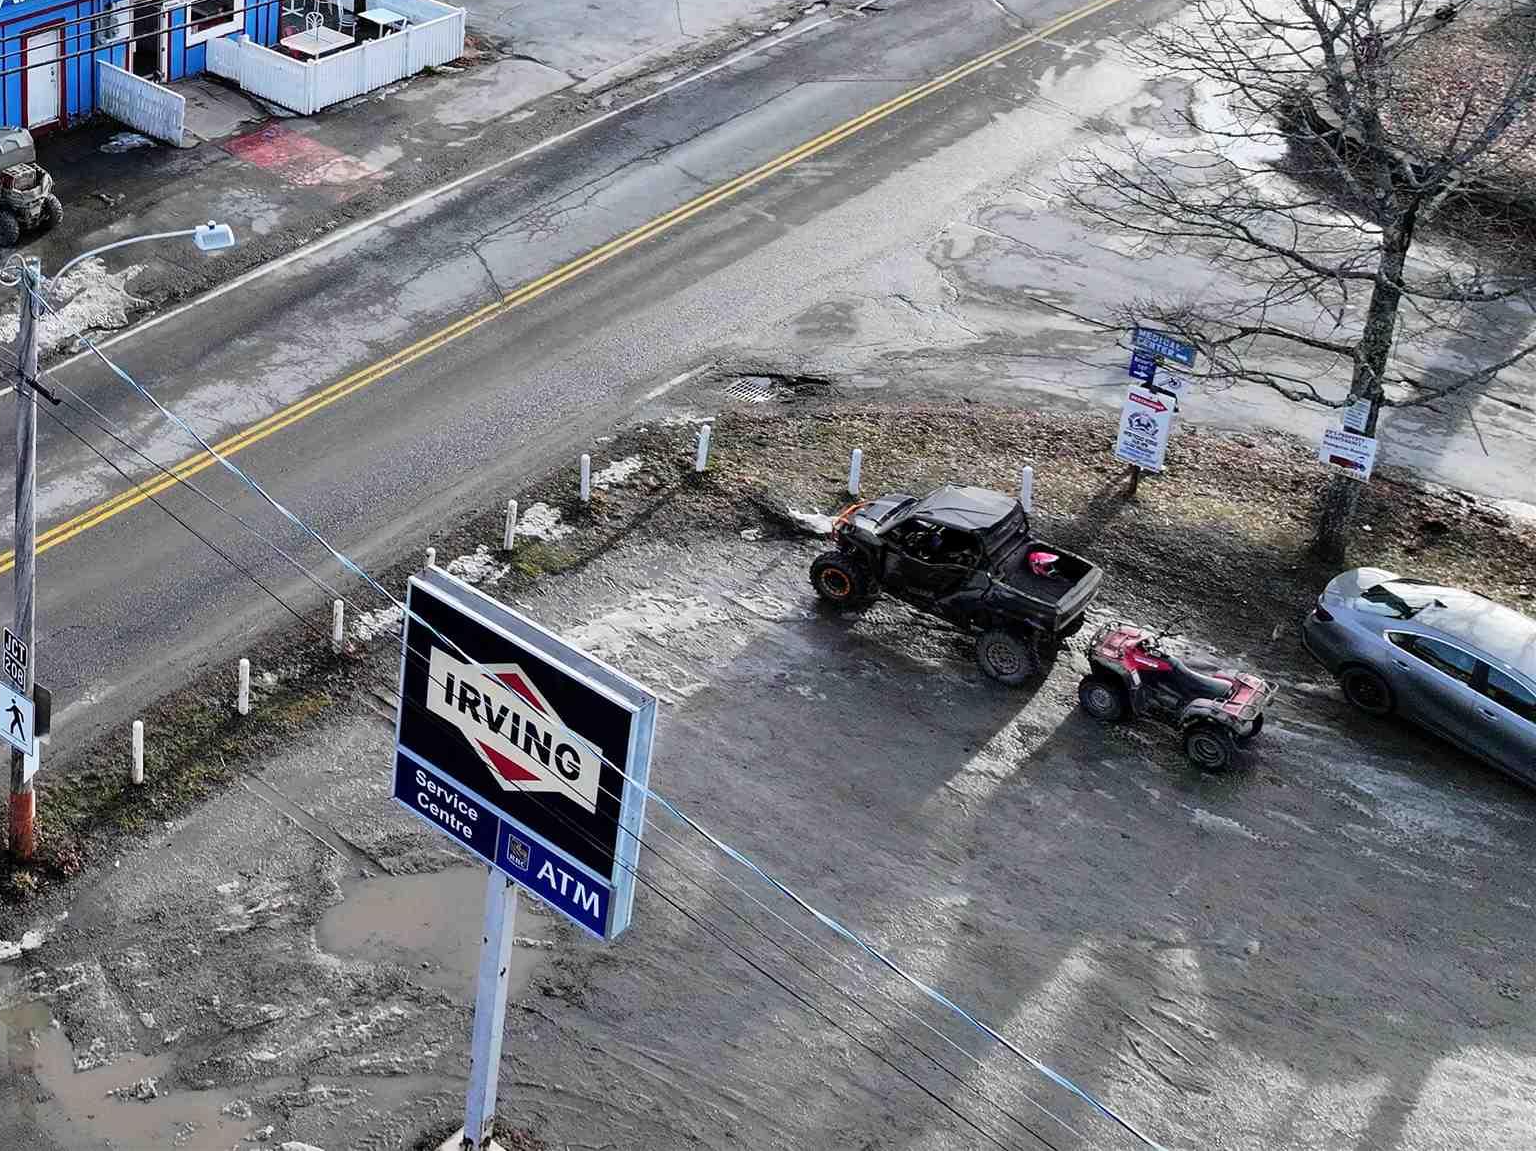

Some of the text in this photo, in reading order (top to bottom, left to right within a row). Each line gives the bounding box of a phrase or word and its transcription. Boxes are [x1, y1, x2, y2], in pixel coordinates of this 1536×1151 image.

[5, 635, 25, 662] JCT
[5, 656, 24, 685] 208
[444, 672, 582, 782] IRVING
[415, 769, 479, 821] Service
[416, 791, 473, 840] Centre
[536, 859, 599, 918] ATM
